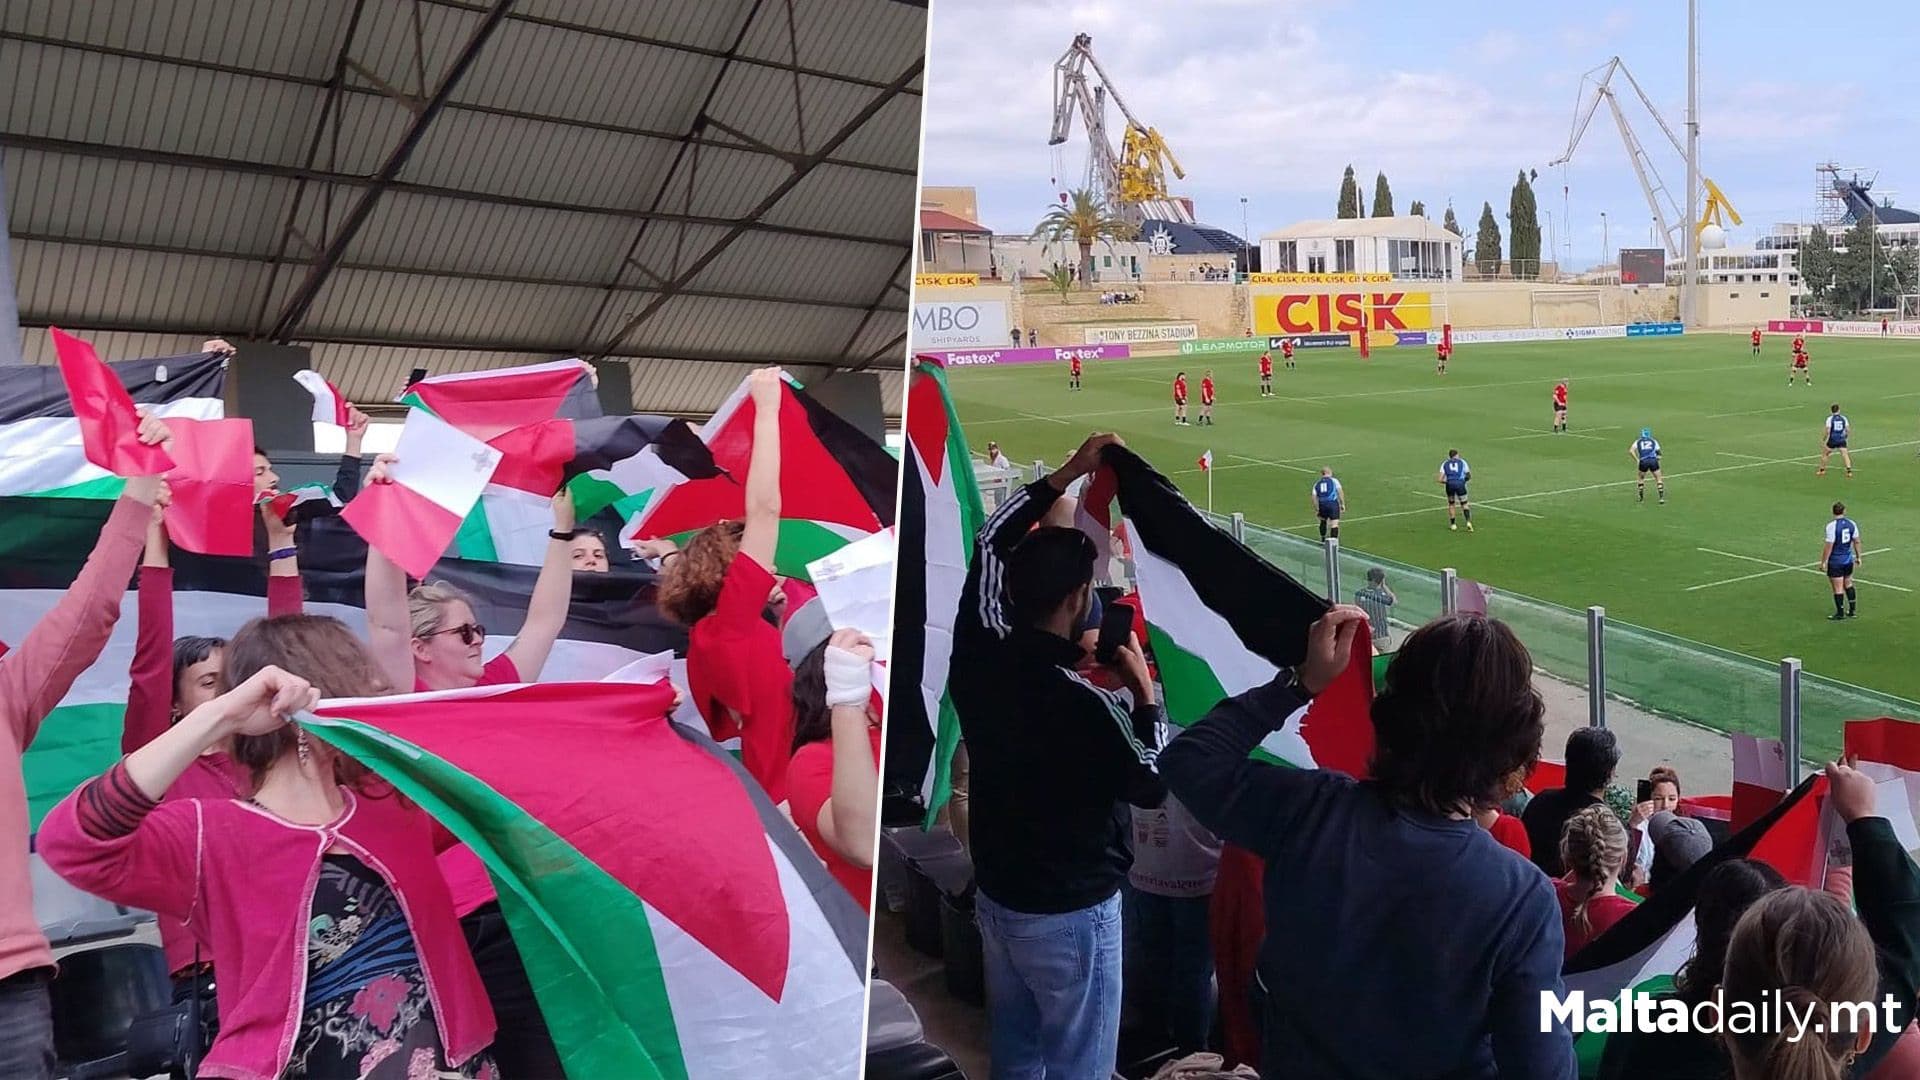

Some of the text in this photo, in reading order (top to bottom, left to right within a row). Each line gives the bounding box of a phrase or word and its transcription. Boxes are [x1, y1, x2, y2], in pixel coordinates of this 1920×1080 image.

[947, 277, 976, 286] CISK
[1277, 293, 1408, 333] CISK
[1104, 327, 1195, 341] TONY BEZZINA STADIUM
[931, 336, 981, 344] SHIPYARDS
[1195, 341, 1265, 351] LEAPMOTOR
[947, 352, 996, 365] Fastex
[1055, 348, 1099, 360] Fatex
[1640, 441, 1652, 450] 12
[1449, 462, 1459, 472] 4
[1320, 483, 1328, 493] 11
[1841, 528, 1851, 544] 6
